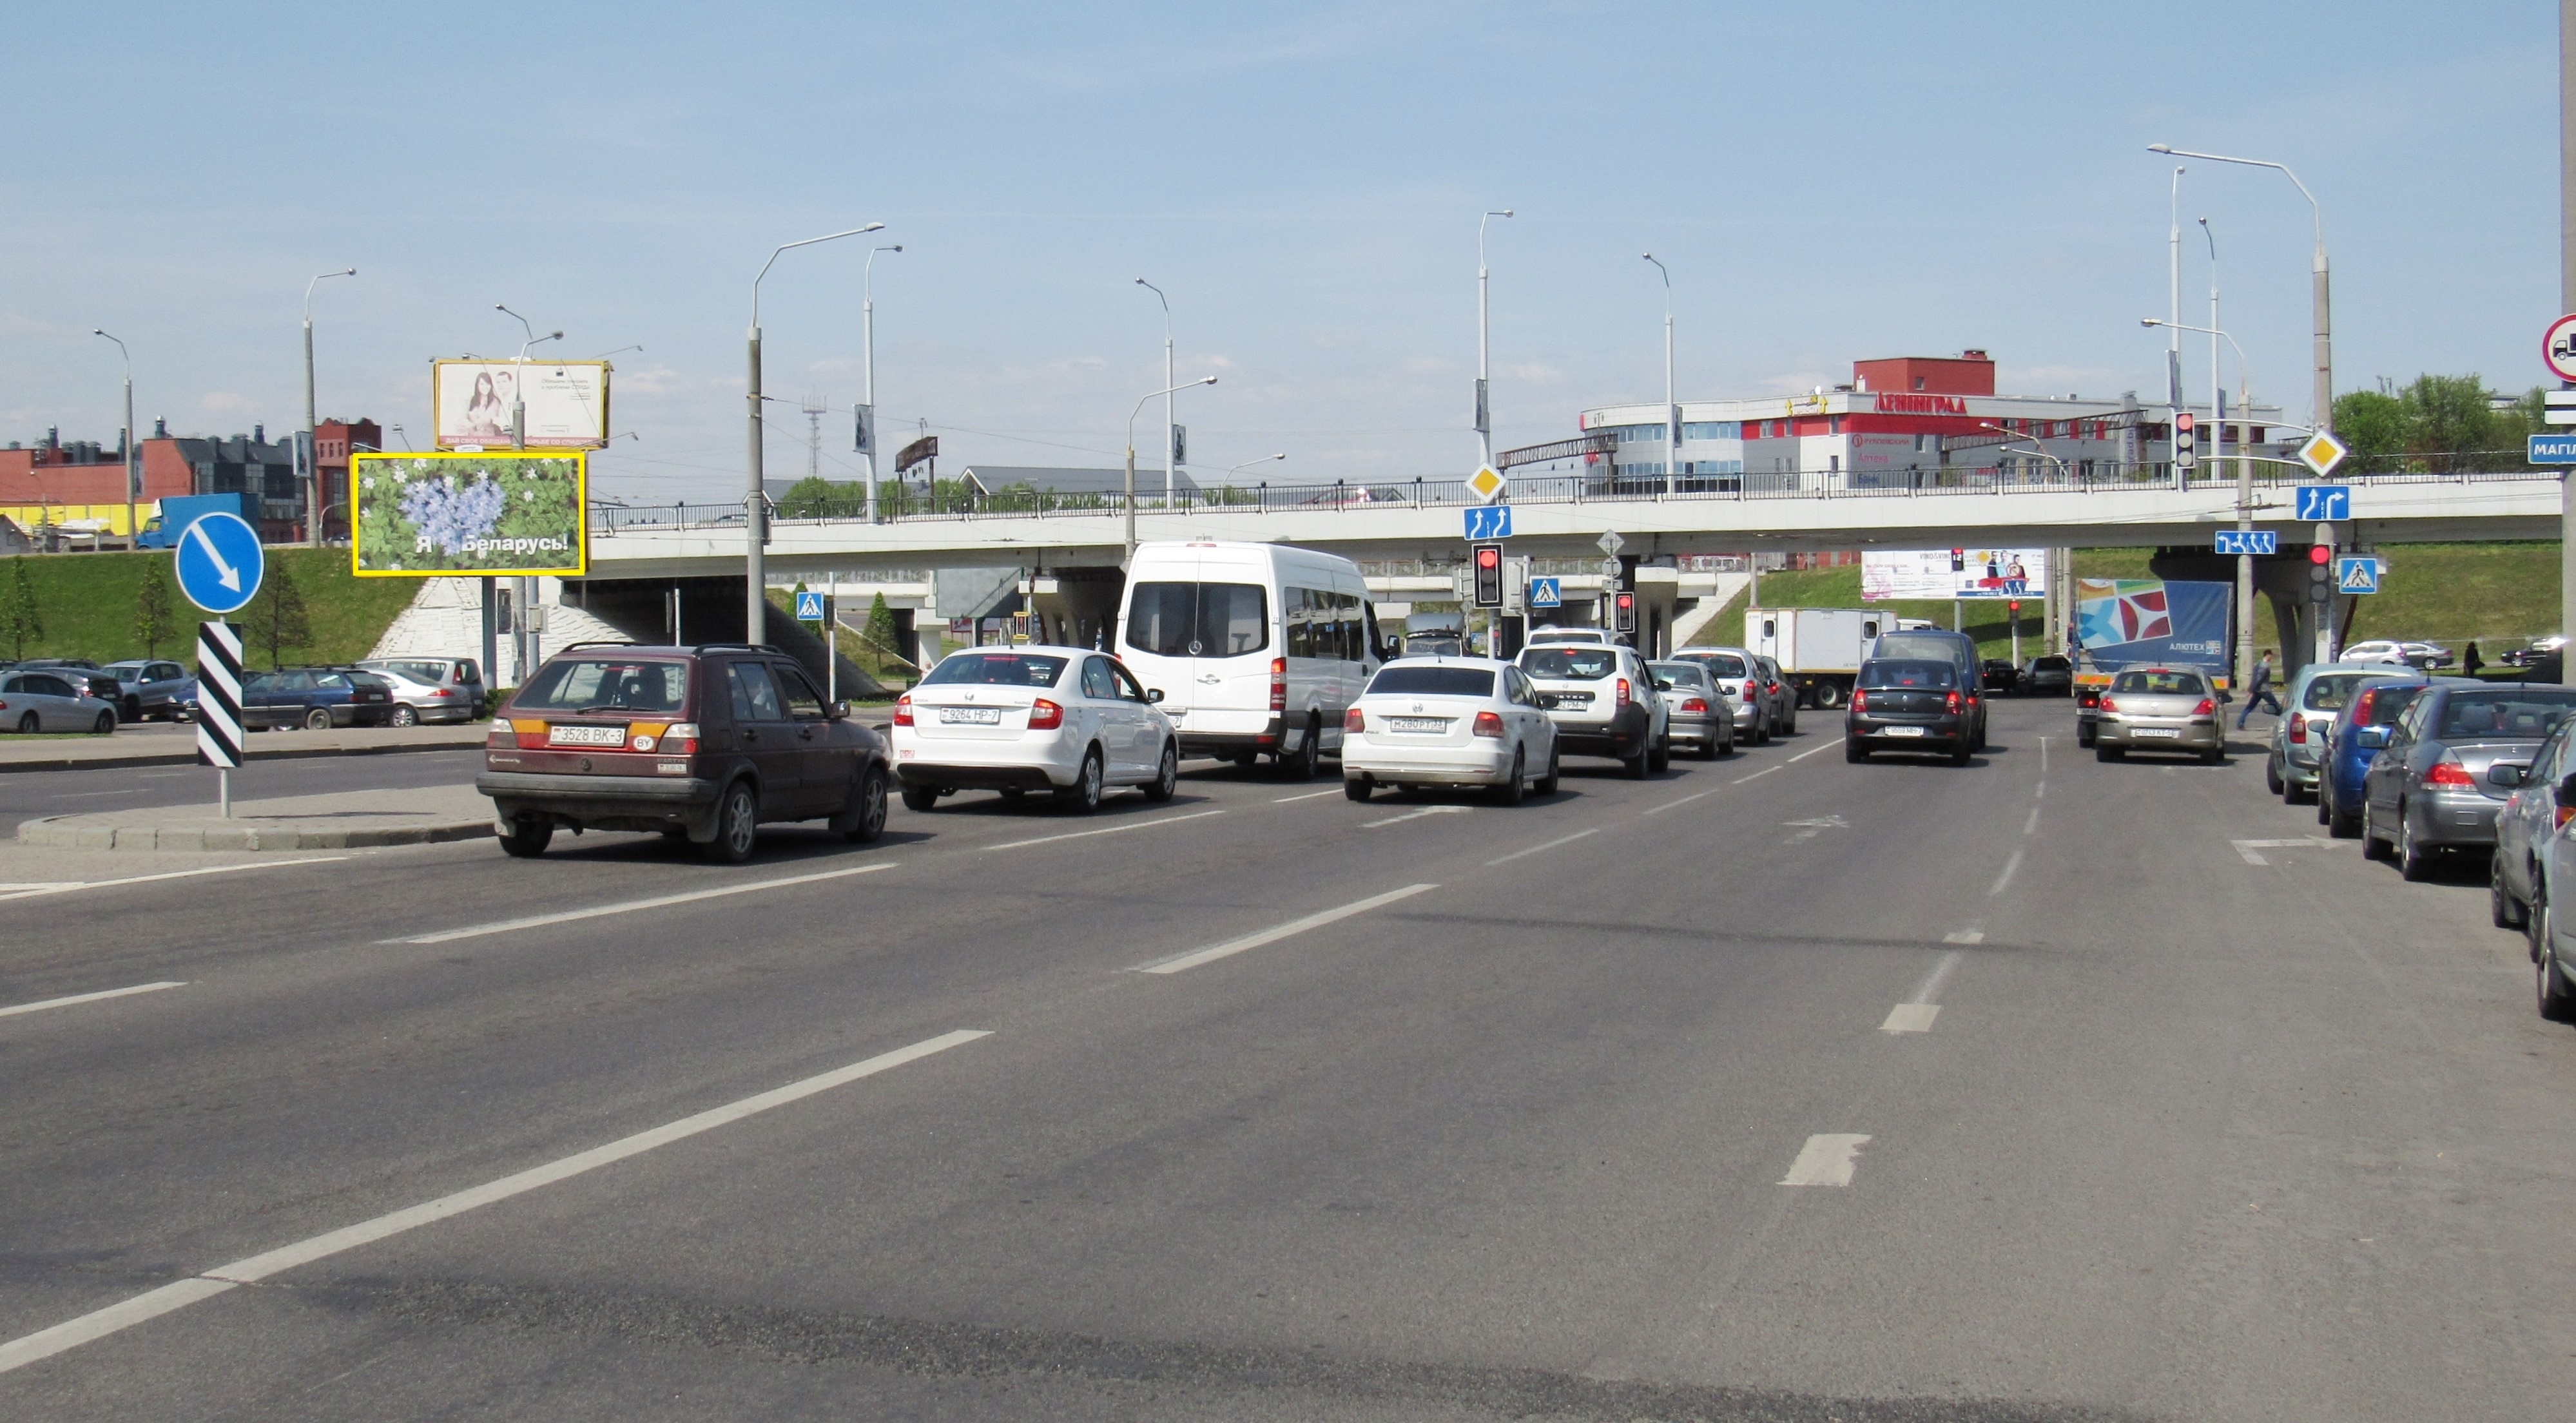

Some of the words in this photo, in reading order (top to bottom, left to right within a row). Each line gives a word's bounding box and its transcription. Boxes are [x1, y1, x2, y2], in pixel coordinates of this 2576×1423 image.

[1859, 453, 1888, 463] Аптека
[416, 535, 432, 554] Я
[461, 533, 568, 556] Беларусь!
[2169, 643, 2205, 651] АЛЮТЕХ
[949, 709, 971, 719] 9264
[974, 710, 998, 721] HP-7
[561, 728, 590, 742] 3528
[593, 729, 623, 742] BK-3
[637, 739, 650, 748] BY
